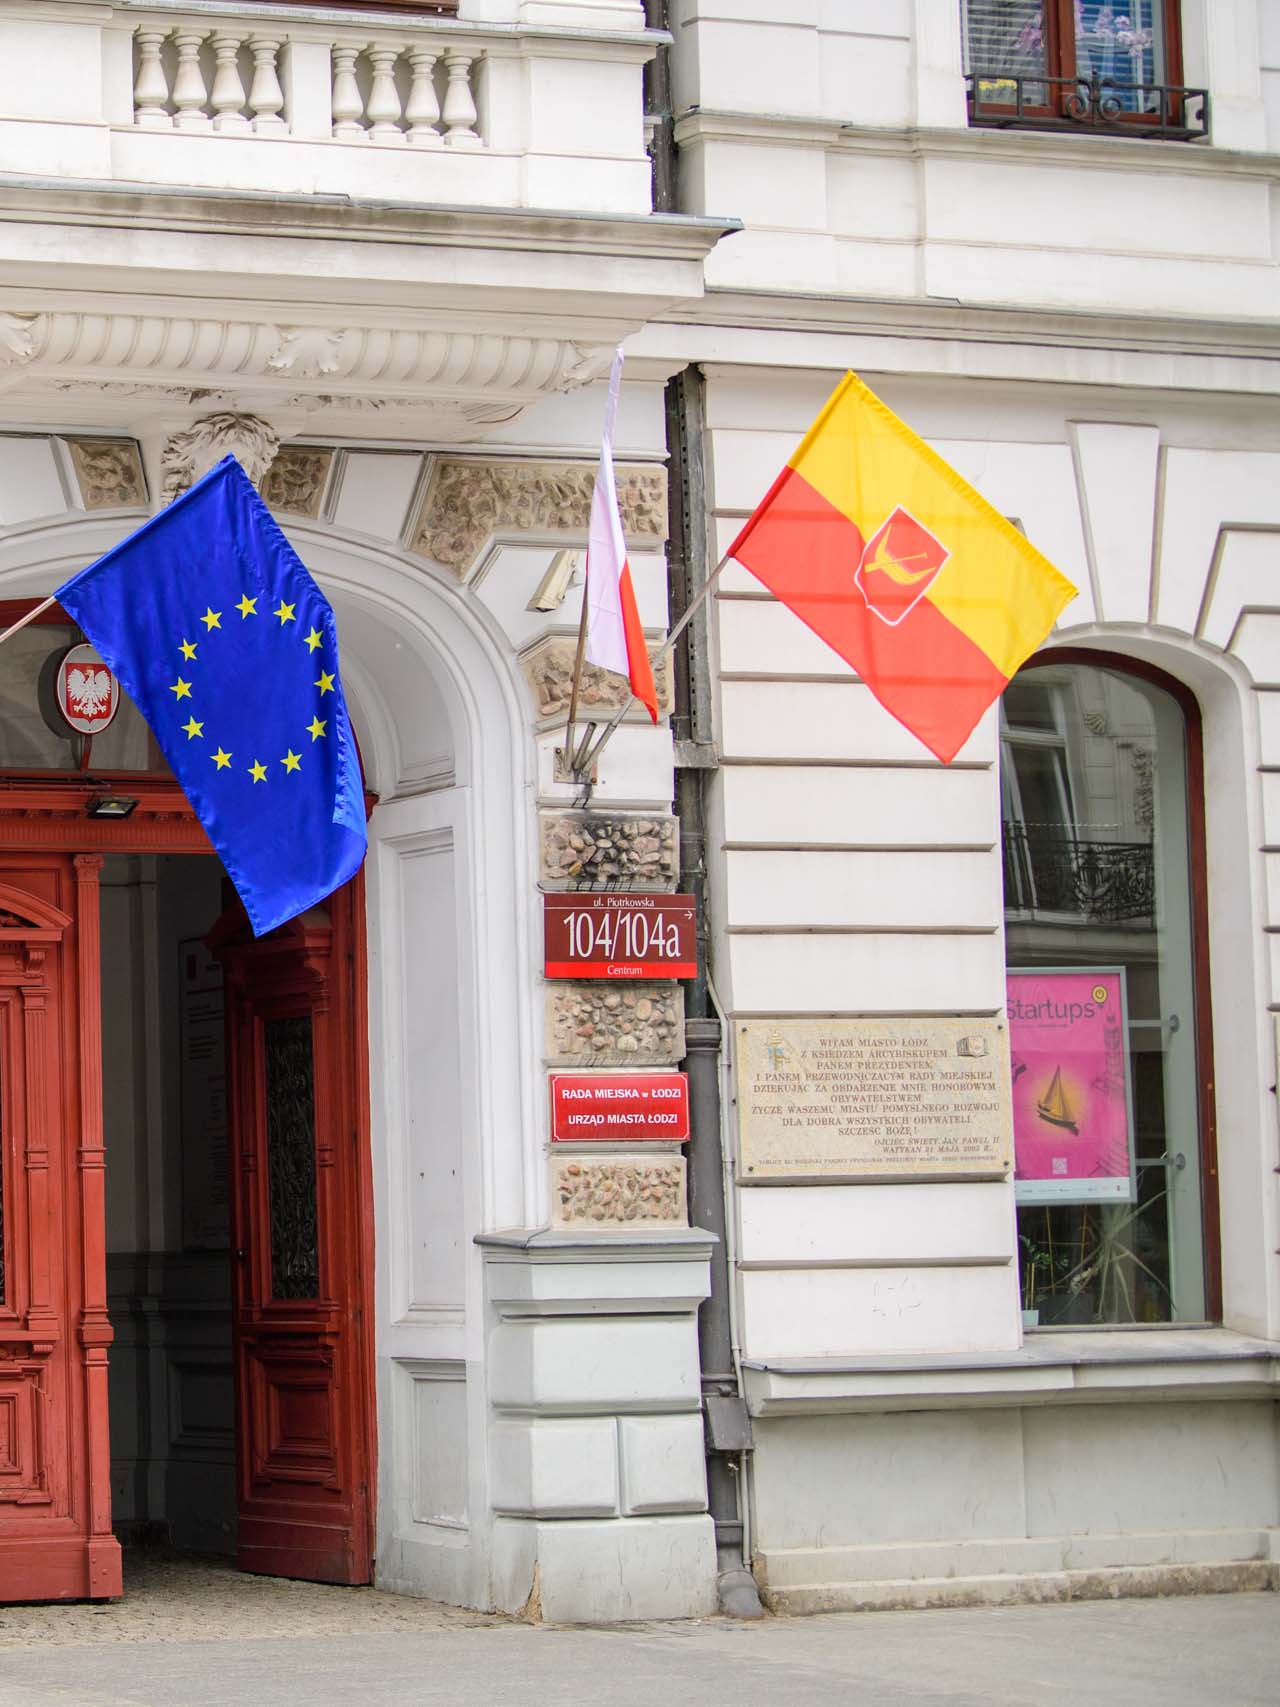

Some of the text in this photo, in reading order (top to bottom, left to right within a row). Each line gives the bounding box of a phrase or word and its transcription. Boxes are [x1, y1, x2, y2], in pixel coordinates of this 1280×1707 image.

[593, 897, 655, 907] ul. Piotrkowska
[563, 910, 682, 960] 104/104a
[607, 965, 643, 975] Centrum
[1007, 999, 1095, 1024] Startups
[819, 1039, 853, 1047] WITAM
[859, 1039, 897, 1047] MIASTO
[800, 1050, 808, 1058] Z
[869, 1049, 948, 1058] ARCYBISKUPEM
[817, 1061, 853, 1070] PANEM
[765, 1072, 801, 1081] PANEM
[909, 1071, 936, 1080] RADY
[940, 1071, 993, 1080] MIEJSKIEJ
[815, 1084, 828, 1093] ZA
[901, 1083, 927, 1092] MNIE
[931, 1082, 996, 1091] HONOROWYM
[562, 1089, 593, 1099] RADA
[595, 1089, 639, 1098] MIEJSKA
[651, 1088, 682, 1098] ŁODZI
[830, 1094, 922, 1103] OBYWATELSTWEM
[787, 1105, 835, 1114] WASZEMU
[840, 1104, 877, 1113] MIASTU
[953, 1102, 1000, 1112] ROZWOJU
[568, 1113, 678, 1126] URZĄD MIASTA ŁODZI
[782, 1118, 803, 1127] DLA
[806, 1118, 841, 1126] DOBRA
[846, 1116, 909, 1126] WSZYSTKICH
